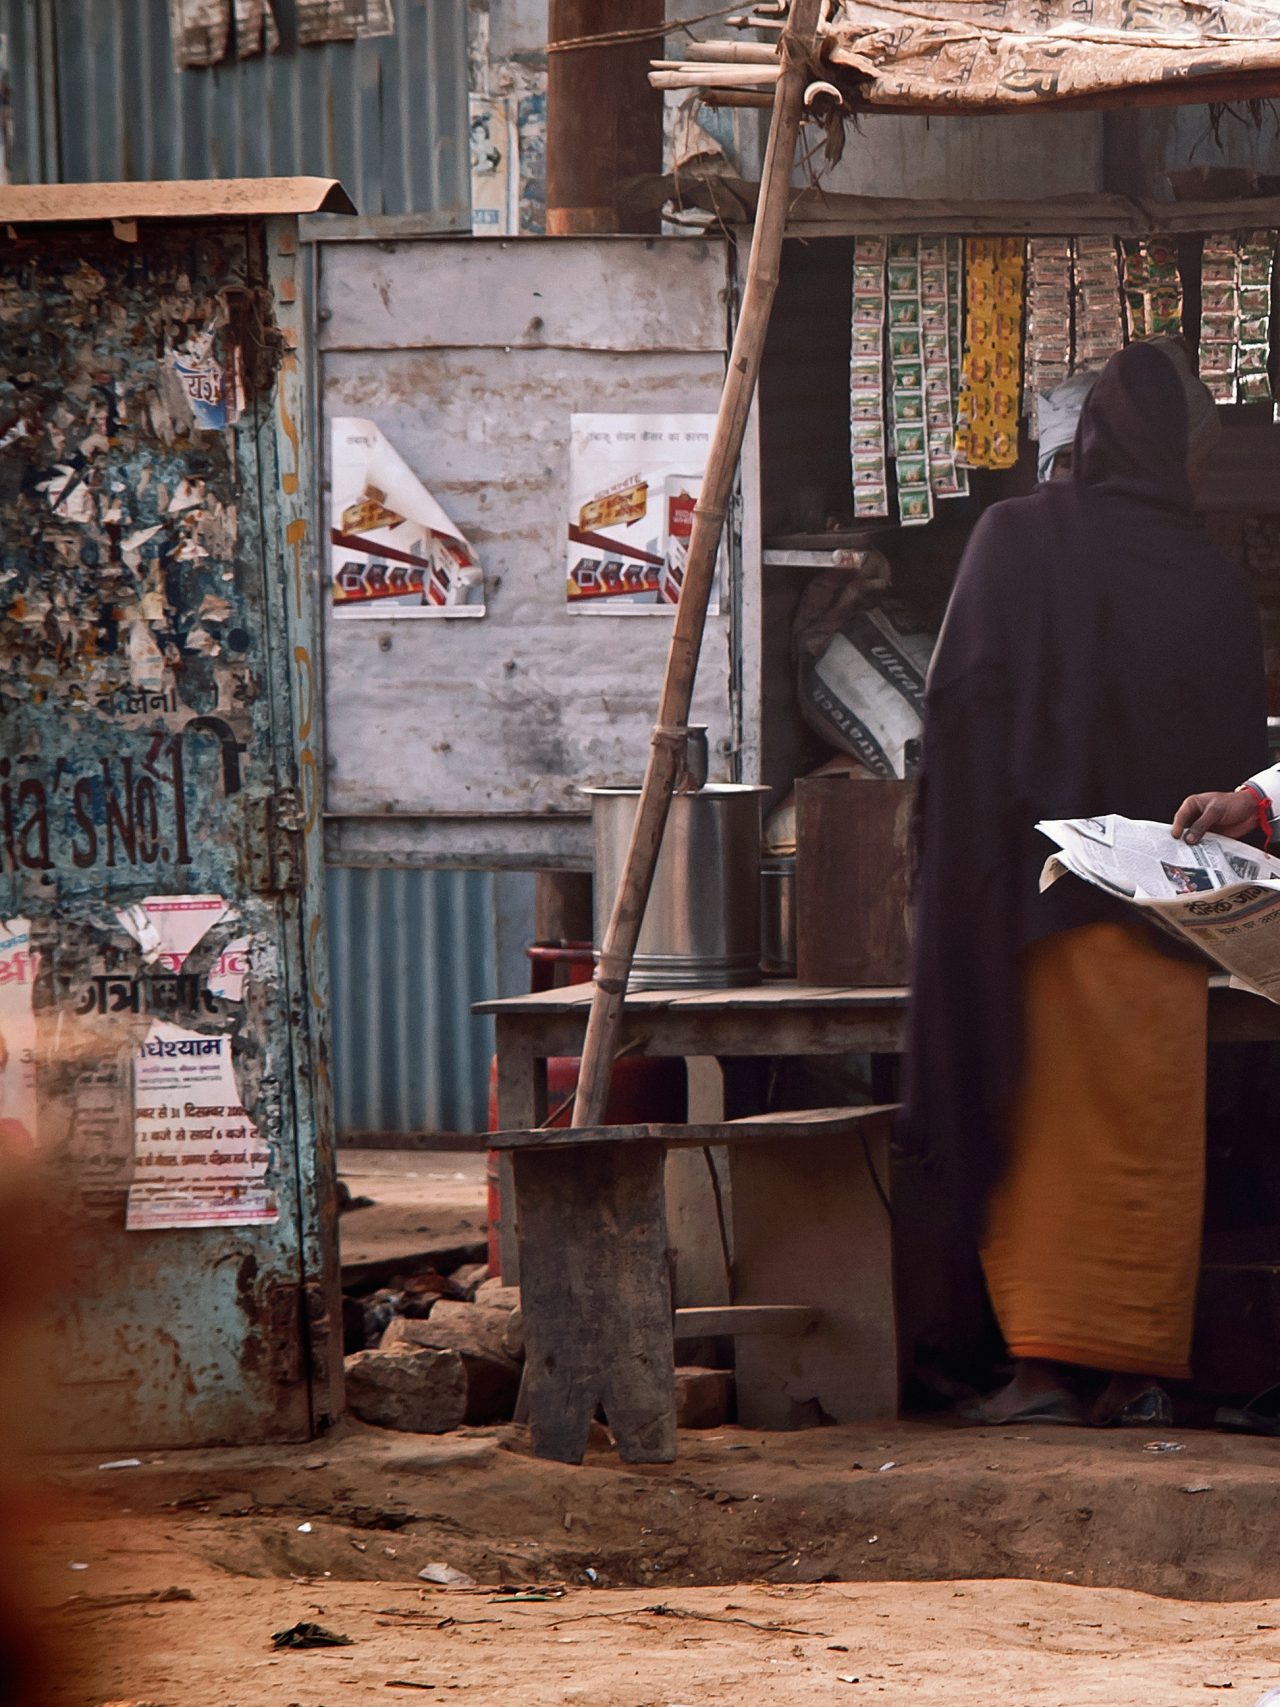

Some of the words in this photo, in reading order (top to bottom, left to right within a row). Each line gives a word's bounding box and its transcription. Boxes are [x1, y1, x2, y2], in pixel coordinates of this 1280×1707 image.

[669, 432, 680, 441] का
[685, 431, 709, 442] कारण
[226, 1125, 247, 1139] बजे
